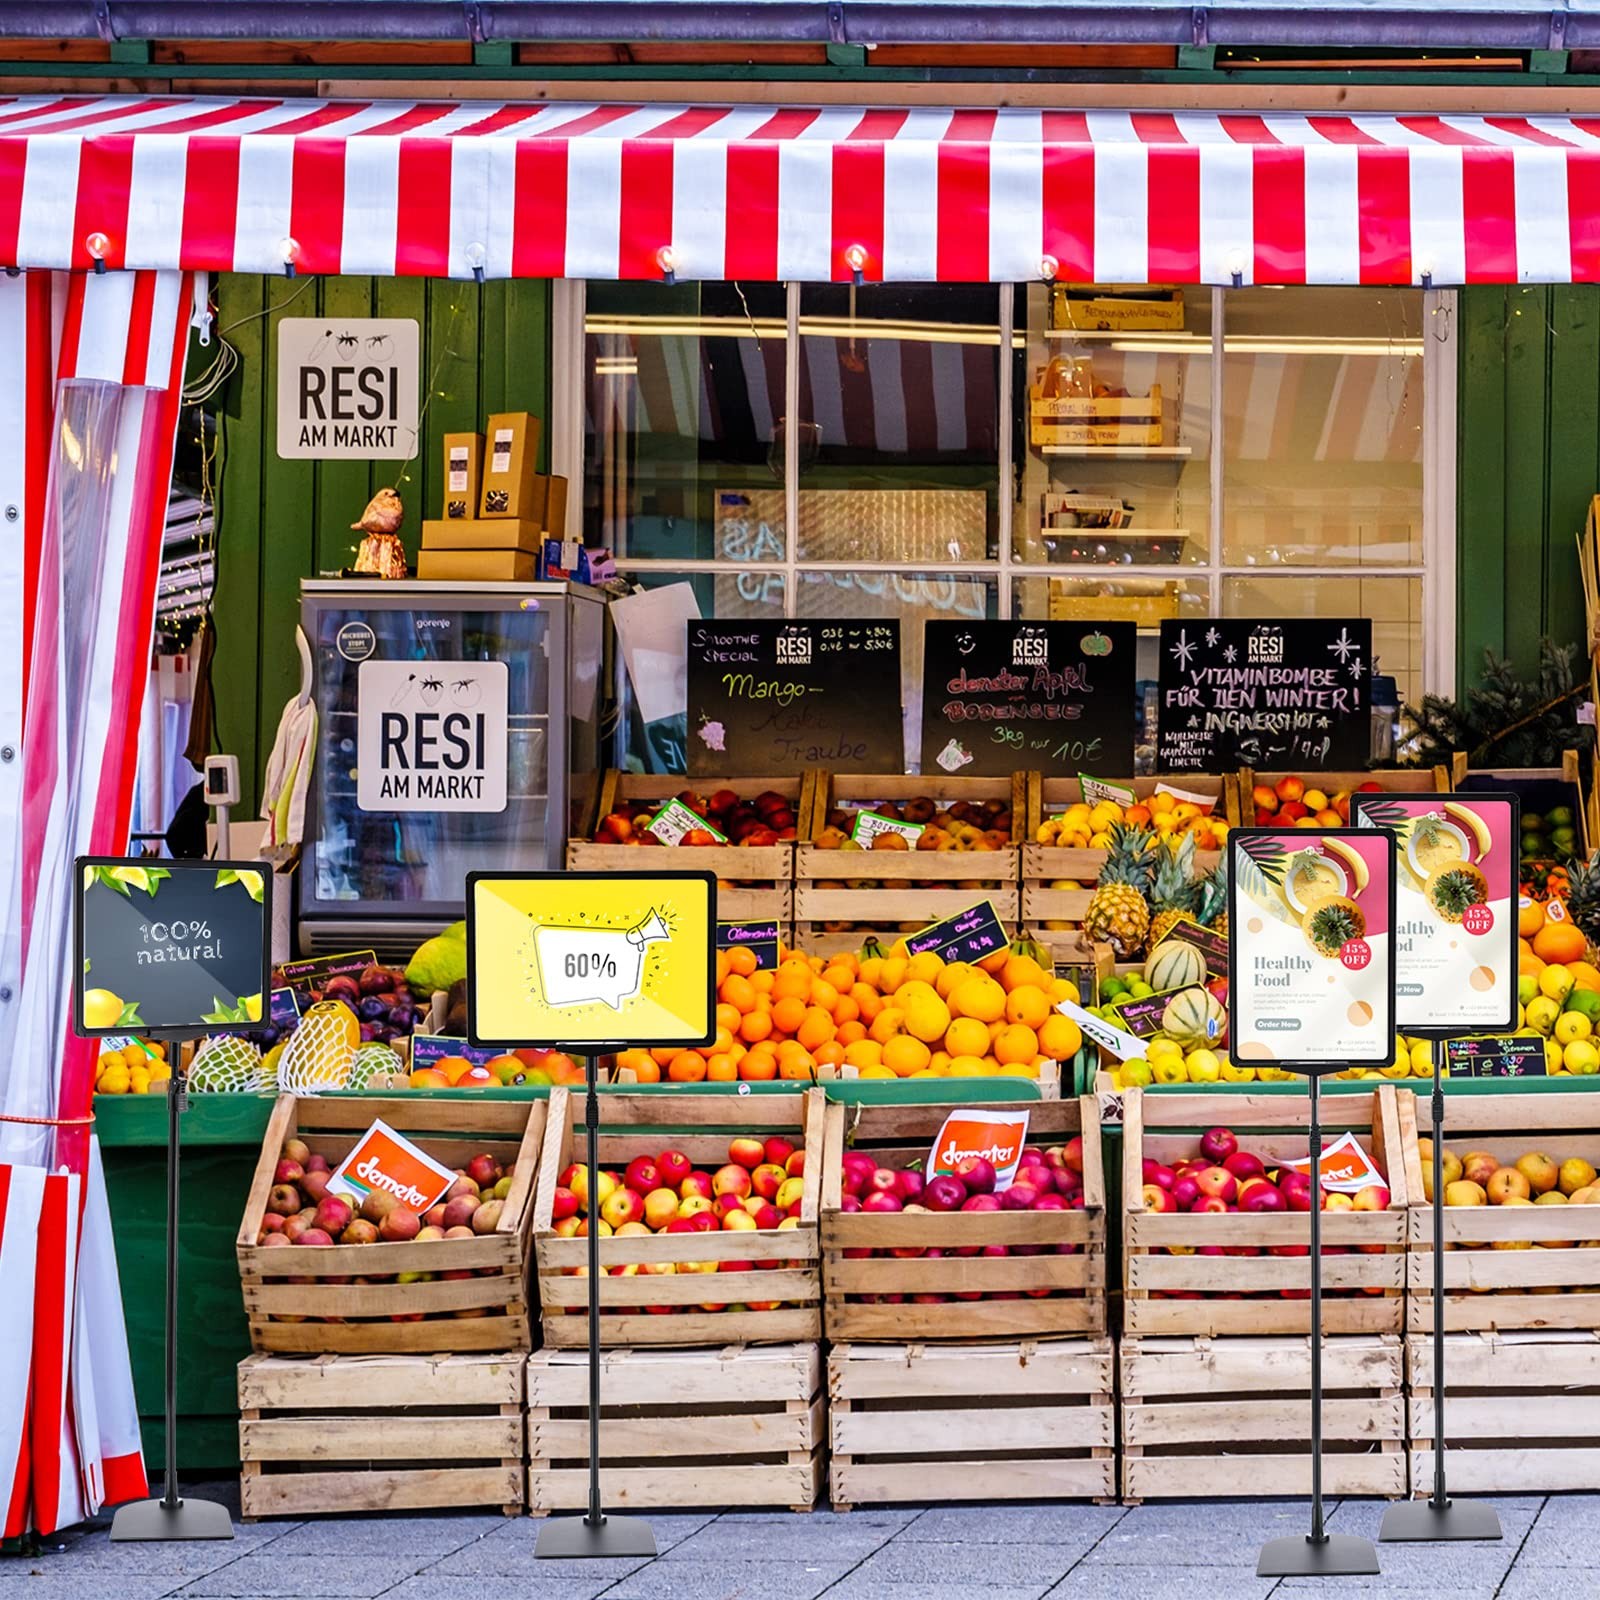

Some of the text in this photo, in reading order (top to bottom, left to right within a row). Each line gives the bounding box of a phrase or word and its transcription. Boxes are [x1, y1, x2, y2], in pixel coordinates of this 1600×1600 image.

[299, 366, 398, 421] RESI
[299, 425, 398, 447] AM MARKT
[416, 619, 451, 629] gorenje
[776, 637, 812, 656] RESI
[1012, 638, 1048, 657] RESI
[1248, 636, 1284, 655] RESI
[776, 656, 811, 664] AM MARKT
[1012, 657, 1048, 666] AM MARKT
[1248, 655, 1283, 663] AM MARKT
[1190, 666, 1340, 690] VITAMINBOMBE
[1166, 685, 1205, 708] FÜR
[942, 700, 1084, 722] BODENSEE
[1204, 710, 1320, 735] INGWERSHOT
[381, 712, 485, 770] RESI
[991, 727, 1025, 749] 3kg
[1031, 738, 1102, 761] nur 10€
[380, 775, 485, 799] AM MARKT
[139, 921, 212, 943] 100%
[1397, 920, 1436, 938] althy
[1466, 921, 1490, 930] OFF
[136, 938, 223, 965] natural
[1343, 955, 1368, 964] OFF
[564, 953, 617, 978] 60%
[1254, 956, 1314, 973] Healthy
[1254, 973, 1291, 987] Food
[1257, 1019, 1300, 1028] Order Now
[356, 1156, 429, 1207] demeter
